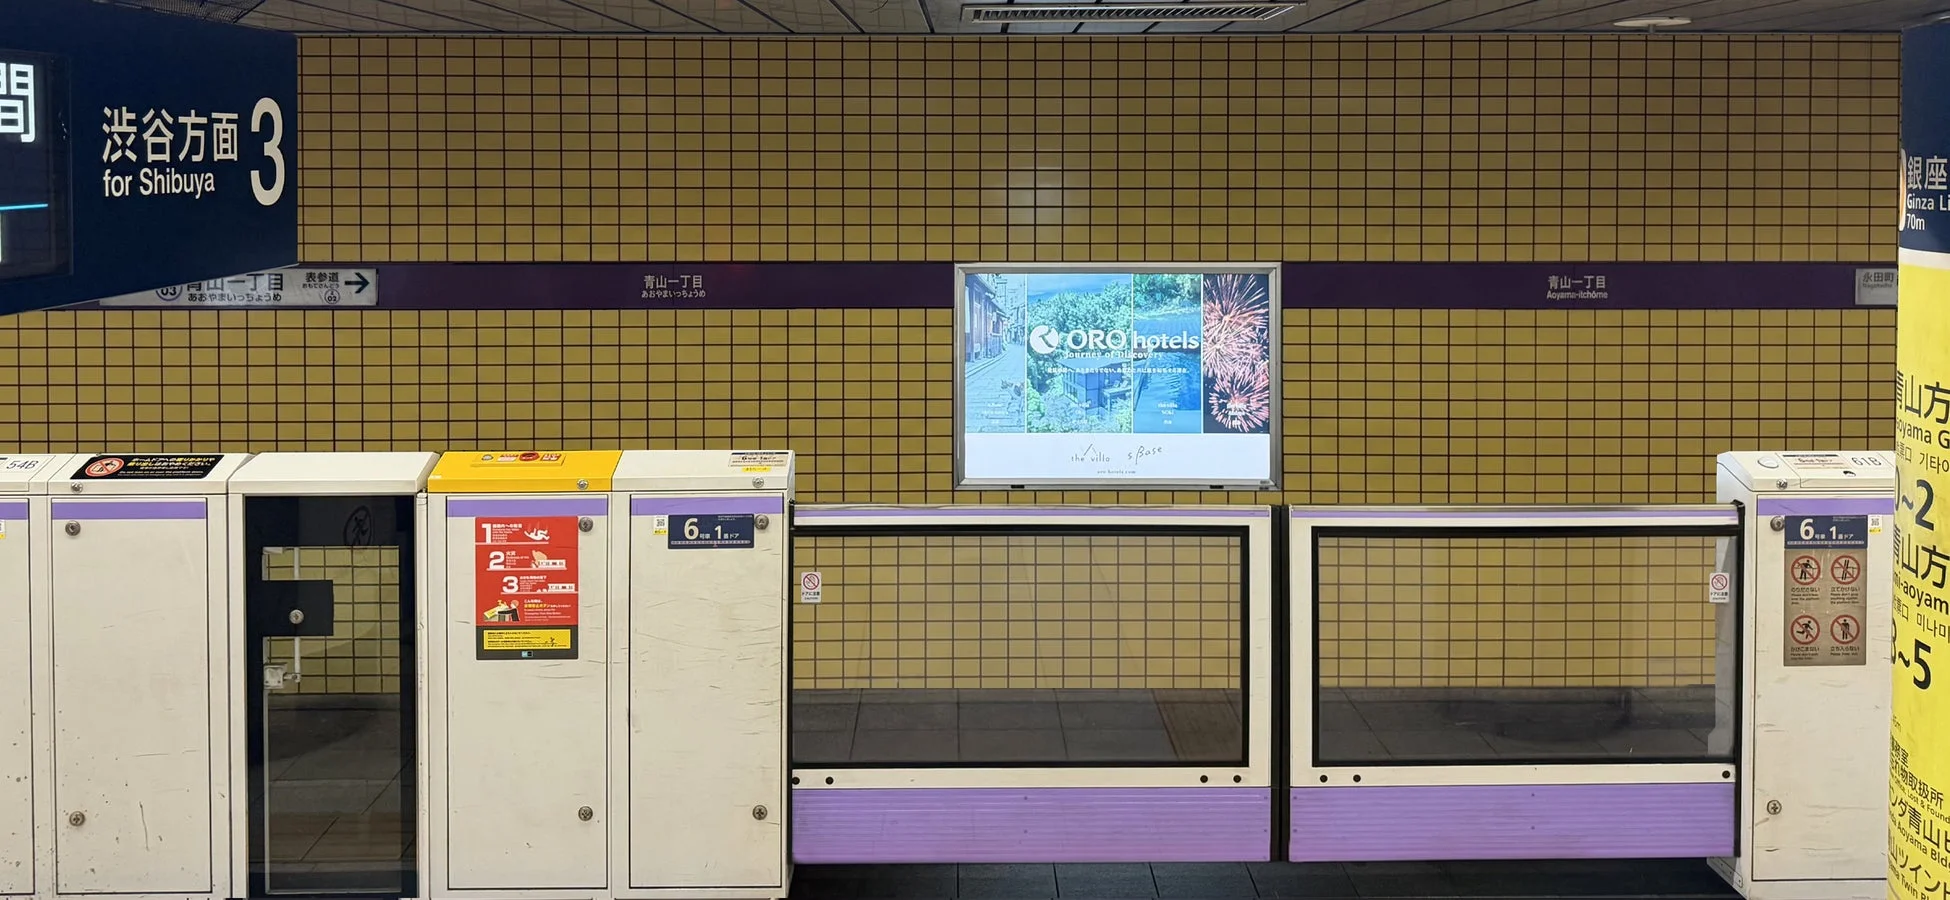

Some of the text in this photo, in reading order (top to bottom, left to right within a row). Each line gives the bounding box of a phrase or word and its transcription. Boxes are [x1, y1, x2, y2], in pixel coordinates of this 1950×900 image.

[102, 106, 239, 163] 渋谷方面
[250, 97, 285, 206] 3
[1907, 155, 1948, 191] 銀座
[103, 168, 215, 199] for Shibuya
[1906, 194, 1934, 210] Ginza
[1906, 214, 1925, 230] 70m
[306, 272, 339, 282] 表参道
[644, 275, 702, 289] 青山一丁目
[1548, 275, 1605, 289] 青山一丁目
[1862, 272, 1894, 282] 永田町
[161, 286, 176, 296] 03
[188, 293, 281, 301] あおやまいっちょうめ
[641, 289, 706, 298] あおやまいっちょうめ
[1067, 329, 1200, 350] ORO hotels
[1064, 351, 1101, 360] Journey
[1105, 351, 1115, 359] of
[6, 459, 39, 470] 54B
[1851, 457, 1882, 466] 61B
[481, 523, 491, 544] 1
[489, 551, 505, 569] 2
[502, 576, 519, 593] 3
[1897, 821, 1928, 854] Aoyama
[1900, 873, 1918, 899] Twin
